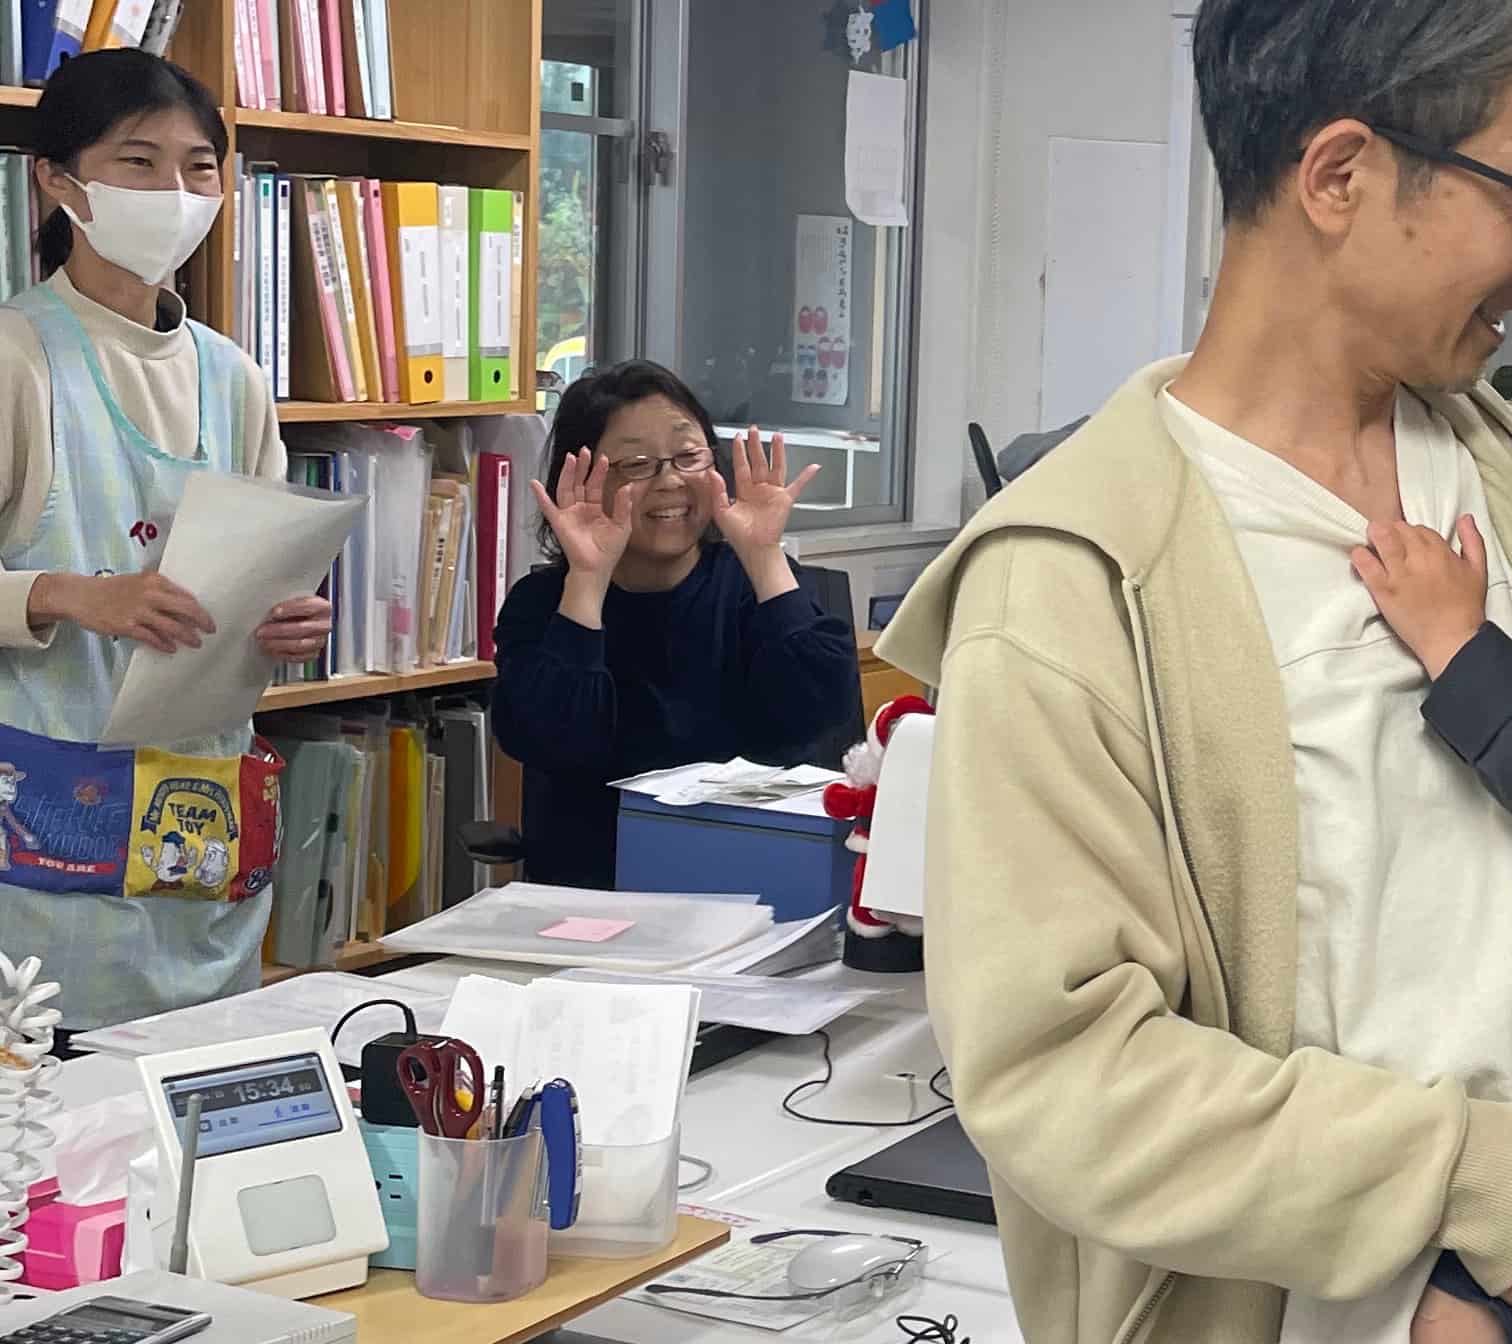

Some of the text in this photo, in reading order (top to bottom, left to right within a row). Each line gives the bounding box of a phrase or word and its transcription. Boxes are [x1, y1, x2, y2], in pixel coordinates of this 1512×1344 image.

[168, 803, 217, 823] TEAM
[176, 818, 205, 836] TOY
[66, 862, 97, 873] ARE
[233, 1076, 294, 1103] 15:34
